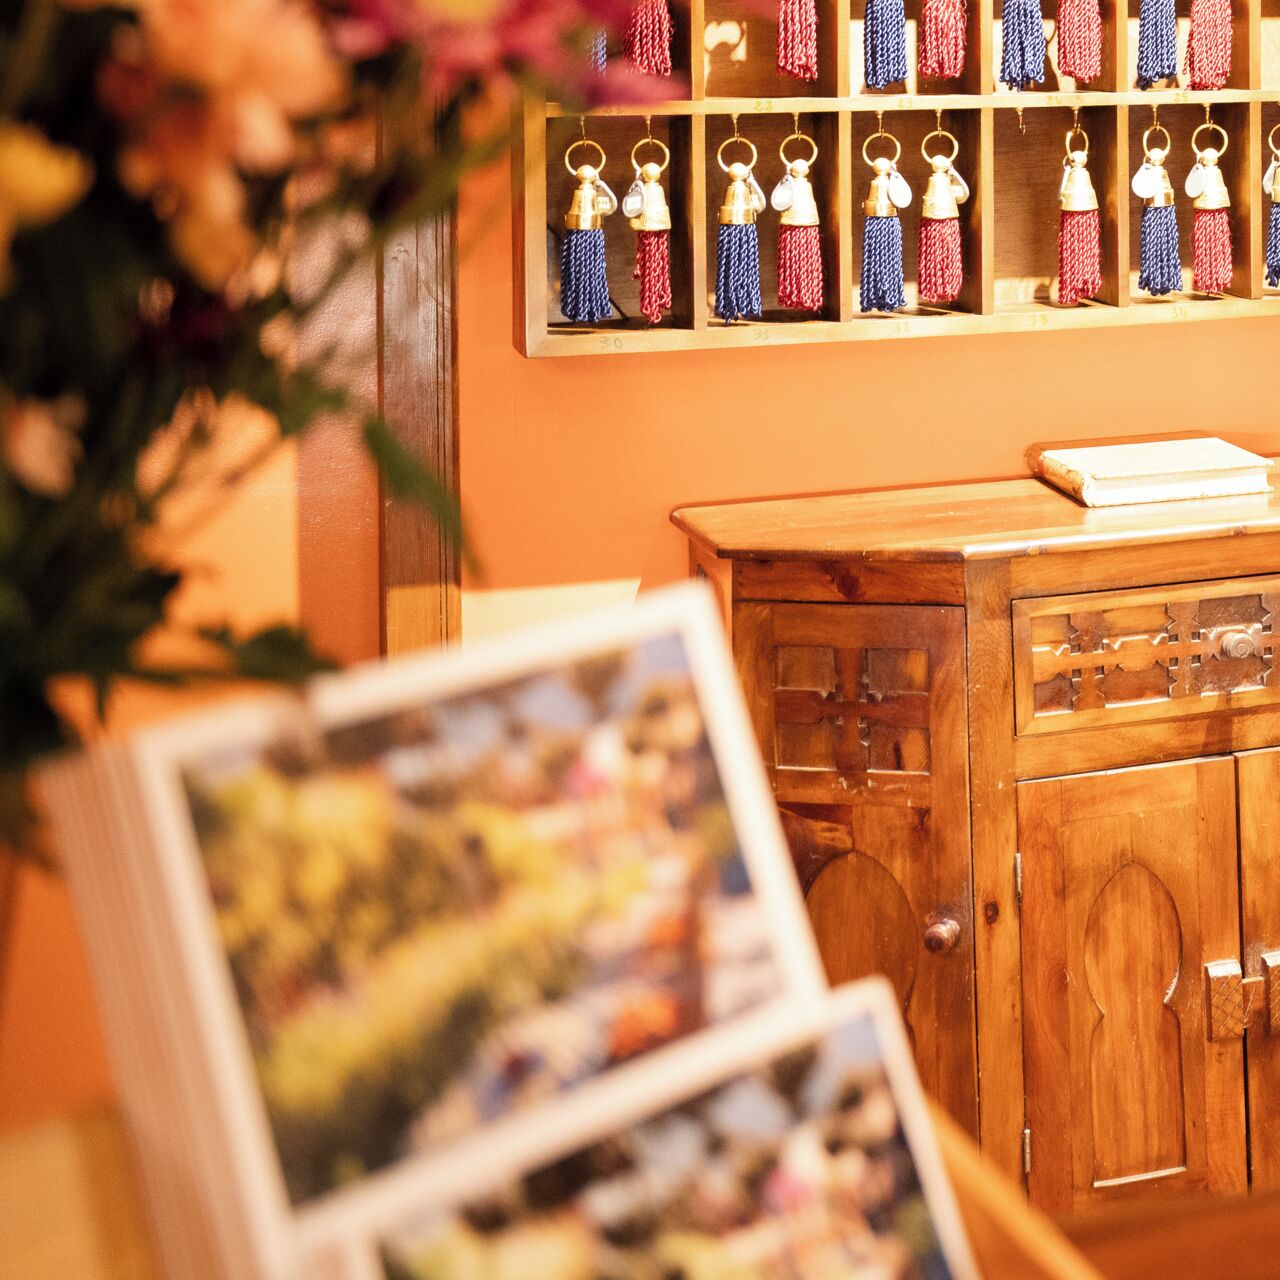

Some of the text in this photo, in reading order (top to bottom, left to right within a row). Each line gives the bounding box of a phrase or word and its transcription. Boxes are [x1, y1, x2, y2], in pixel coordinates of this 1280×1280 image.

[753, 100, 773, 112] 22
[1171, 307, 1187, 319] 34
[1028, 314, 1048, 326] 33
[753, 328, 769, 340] 31
[600, 336, 623, 349] 30
